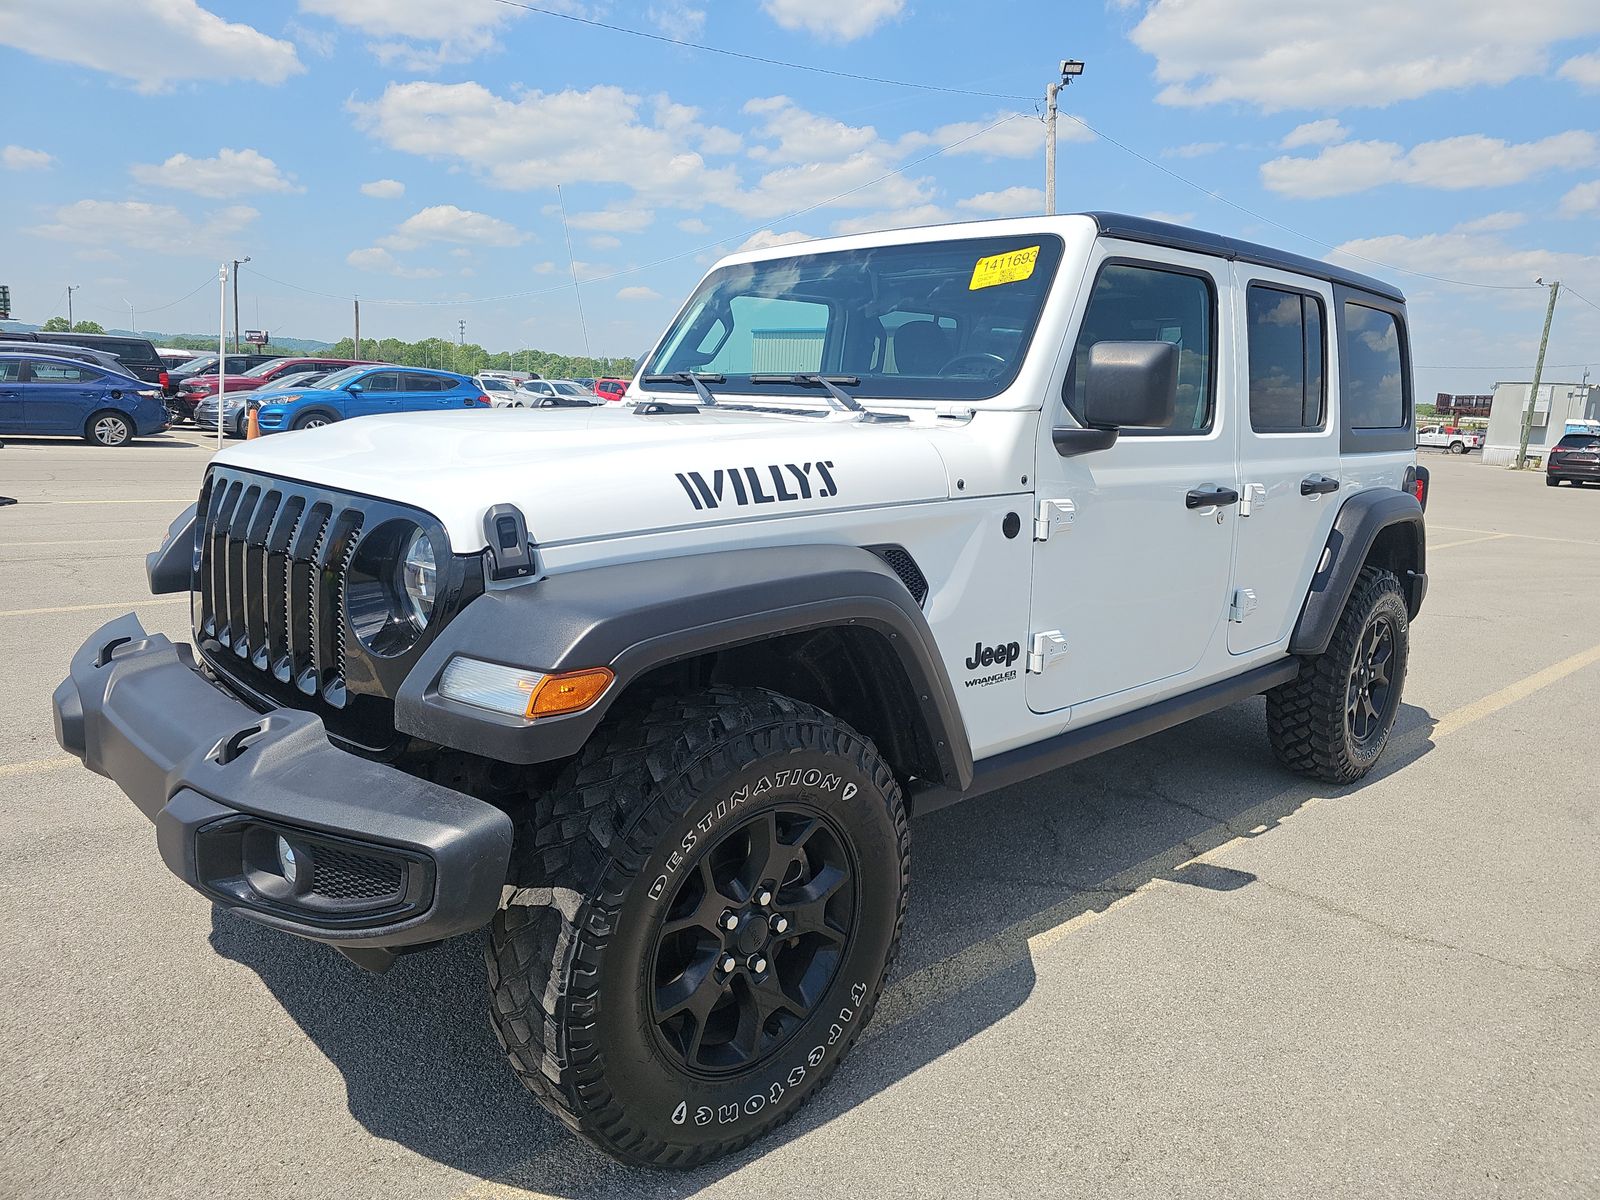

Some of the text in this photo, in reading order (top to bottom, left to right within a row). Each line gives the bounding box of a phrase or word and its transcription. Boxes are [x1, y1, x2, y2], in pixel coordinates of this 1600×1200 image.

[984, 250, 1038, 273] 1411693
[674, 460, 838, 510] WILLYS
[965, 641, 1020, 670] Jeep
[964, 669, 1017, 688] WRANGLER
[648, 768, 842, 901] DESTINATION
